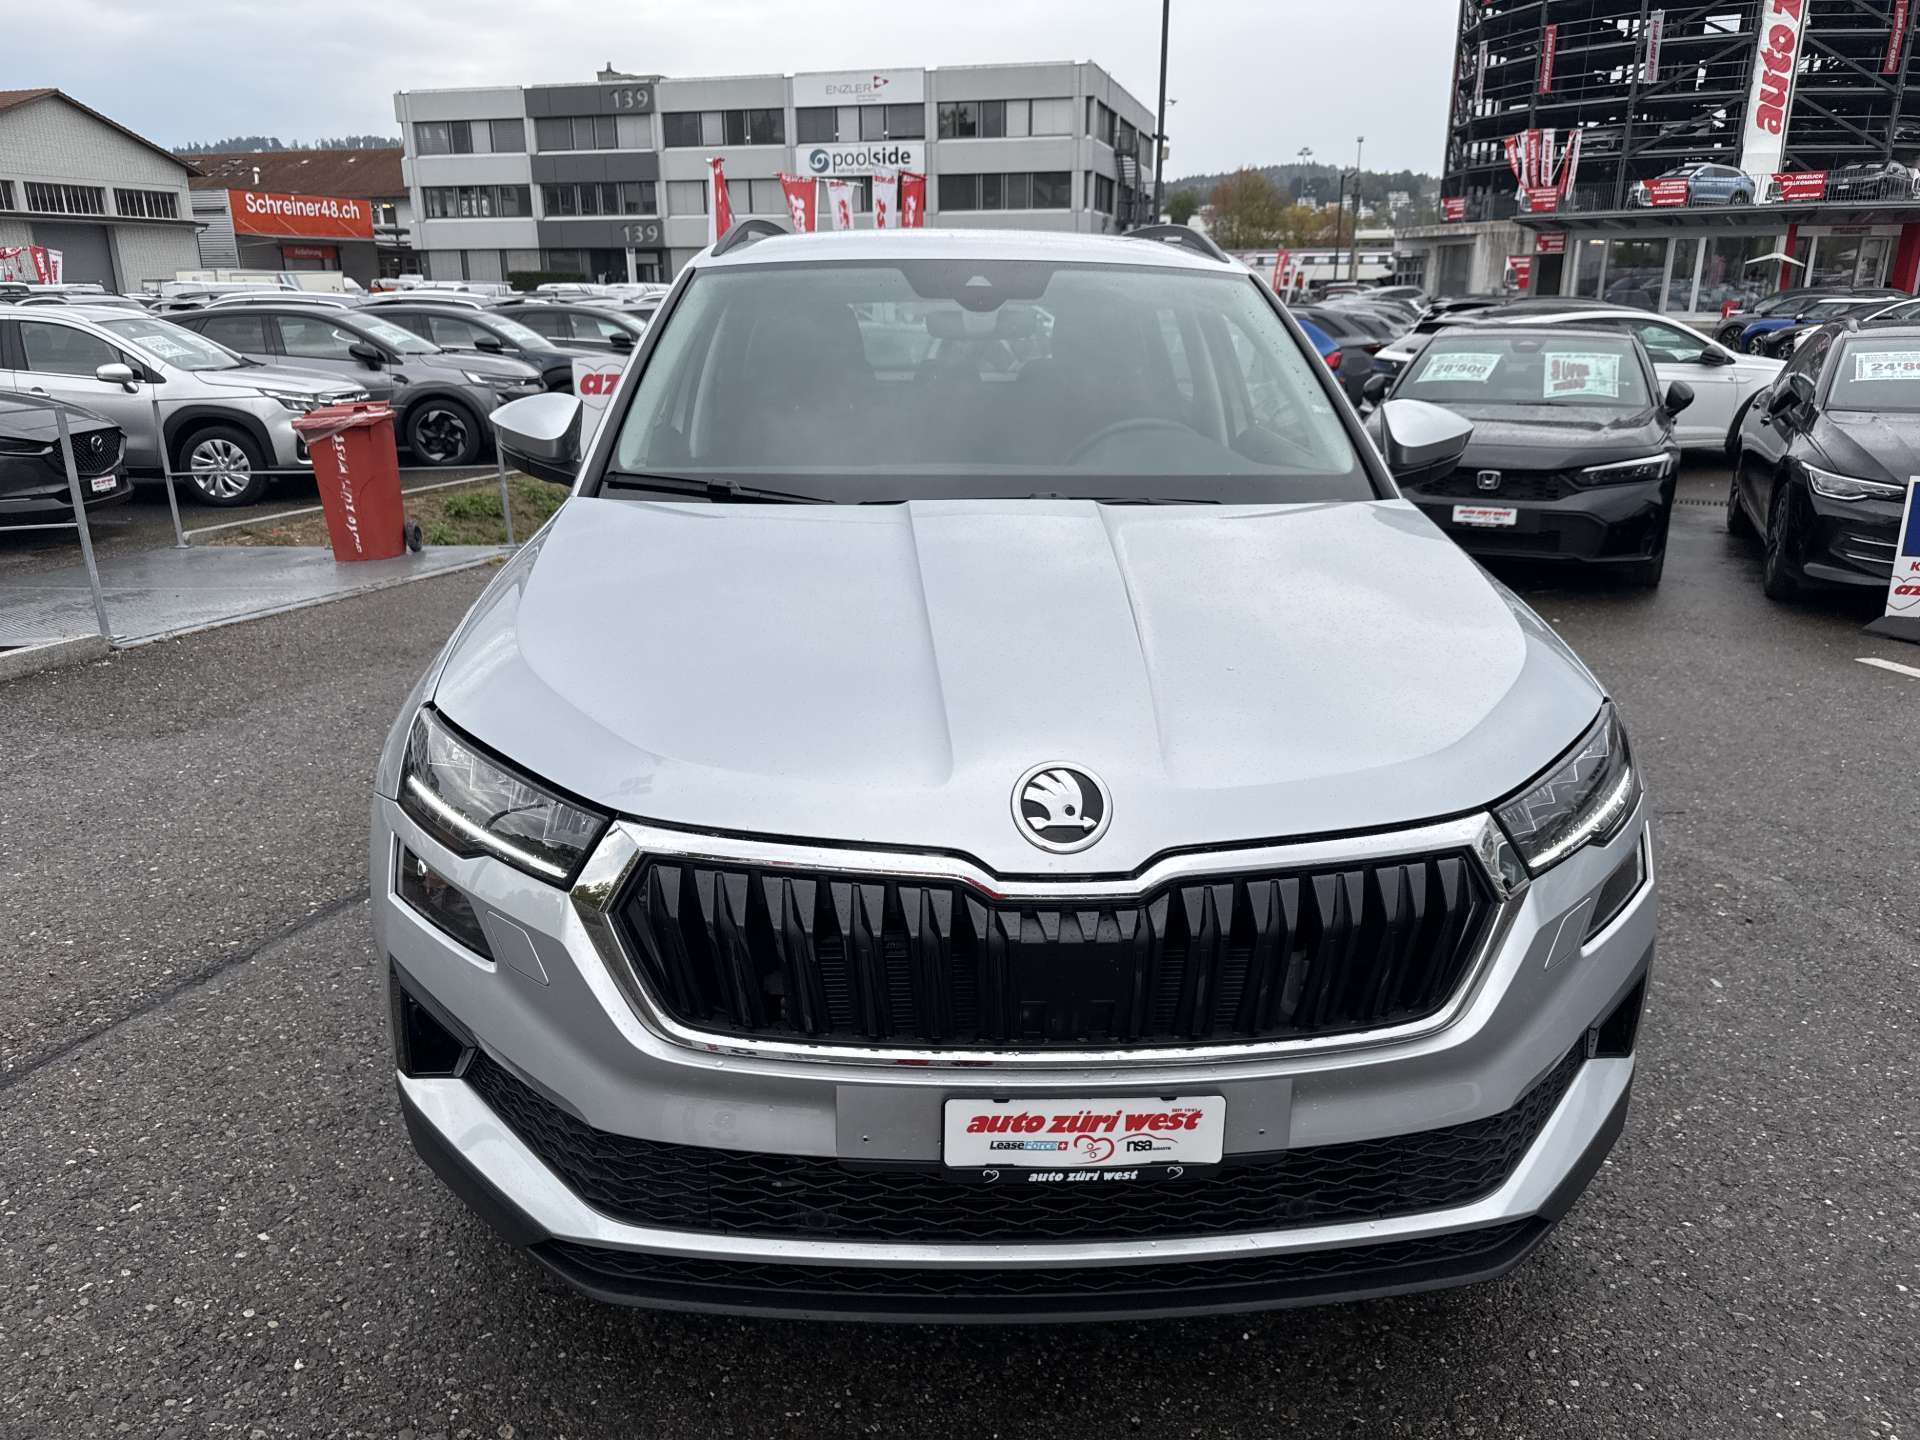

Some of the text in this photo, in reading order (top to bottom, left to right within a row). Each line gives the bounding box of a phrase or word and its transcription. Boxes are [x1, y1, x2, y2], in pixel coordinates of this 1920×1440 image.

[1756, 24, 1795, 135] auto
[825, 83, 871, 95] ENZLER
[611, 90, 649, 108] 139
[832, 146, 912, 174] poolside
[245, 193, 361, 220] Schreiner48.ch
[623, 225, 658, 242] 139
[967, 1110, 1202, 1133] auto züri west
[989, 1140, 1058, 1151] LeaseForce
[1126, 1139, 1152, 1152] nsa
[1028, 1168, 1139, 1182] auto züri west
